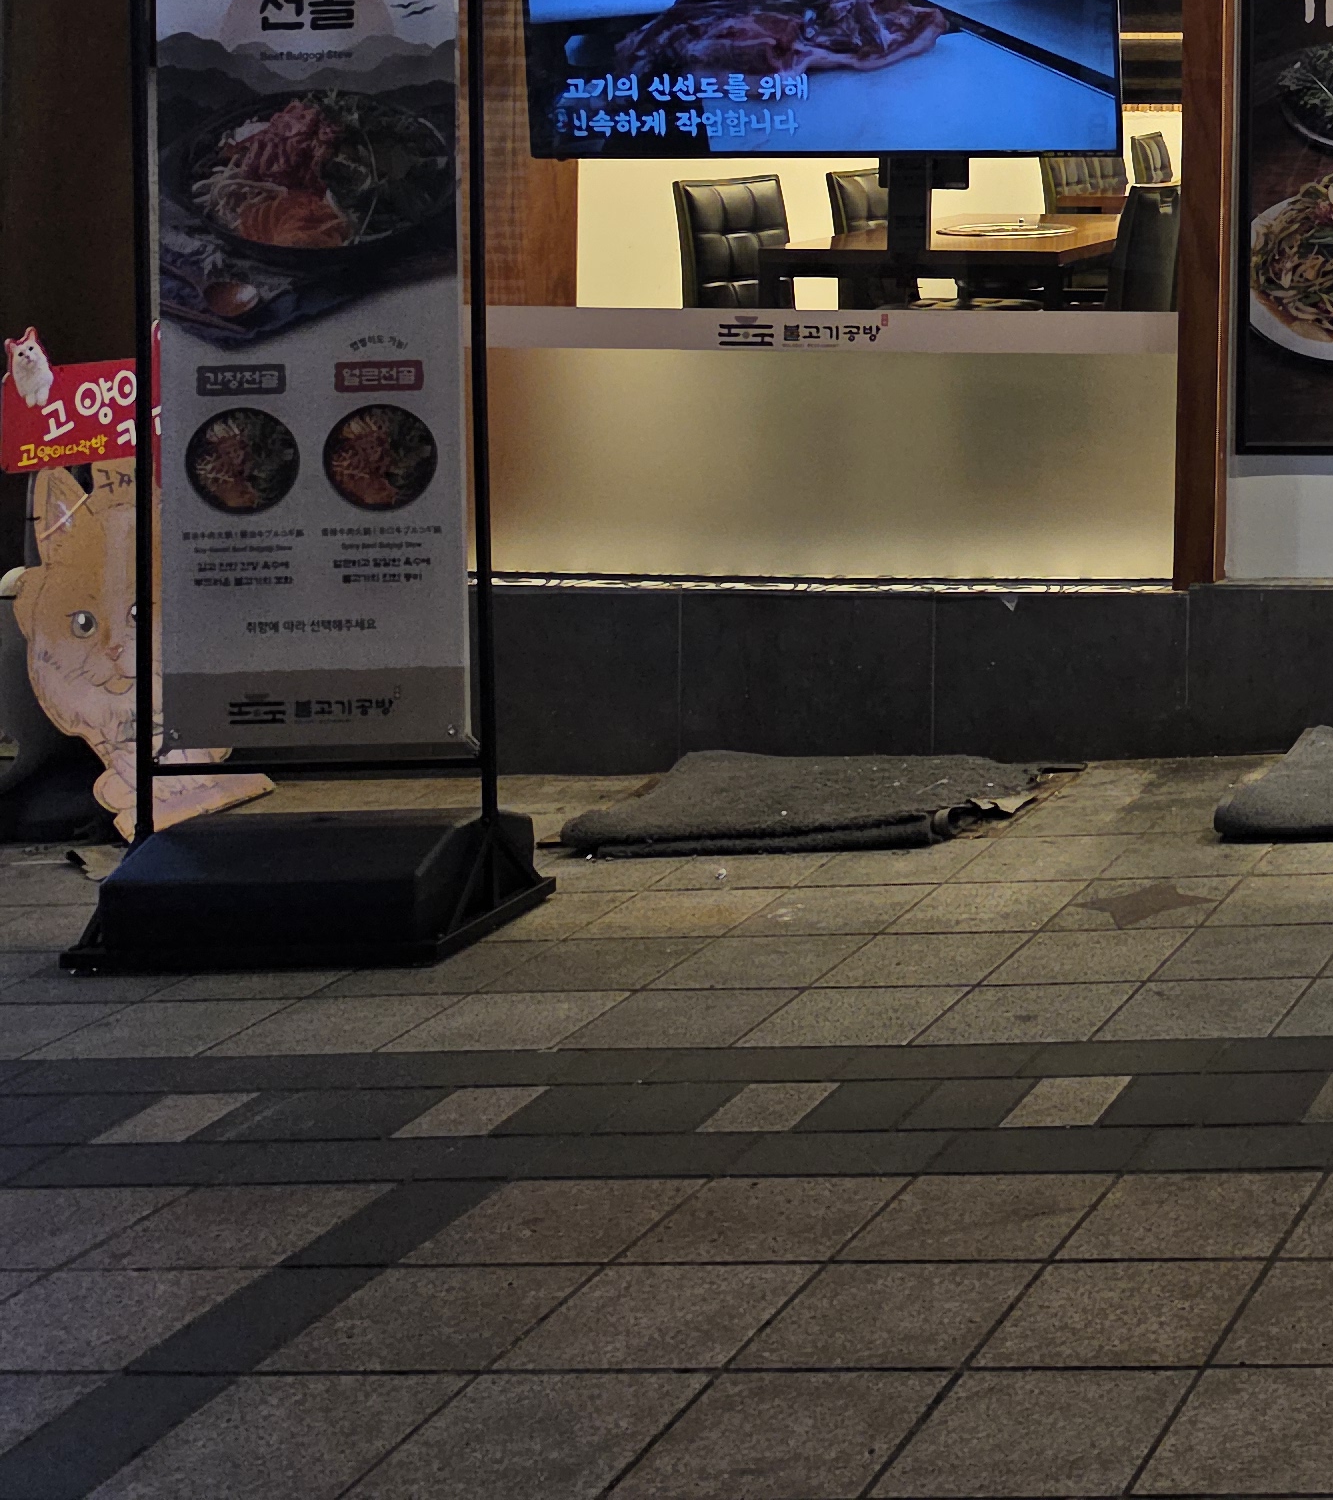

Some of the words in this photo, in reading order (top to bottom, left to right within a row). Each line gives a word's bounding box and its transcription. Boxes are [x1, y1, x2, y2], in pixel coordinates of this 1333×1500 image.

[564, 73, 639, 102] 고기의
[647, 73, 750, 102] 신선도를
[759, 72, 809, 102] 위해
[674, 109, 798, 138] 작업합니다
[784, 324, 881, 342] 불고기공방
[204, 369, 280, 390] 간장전골
[343, 367, 415, 387] 얼큰전골
[294, 697, 394, 718] 불고기공방
